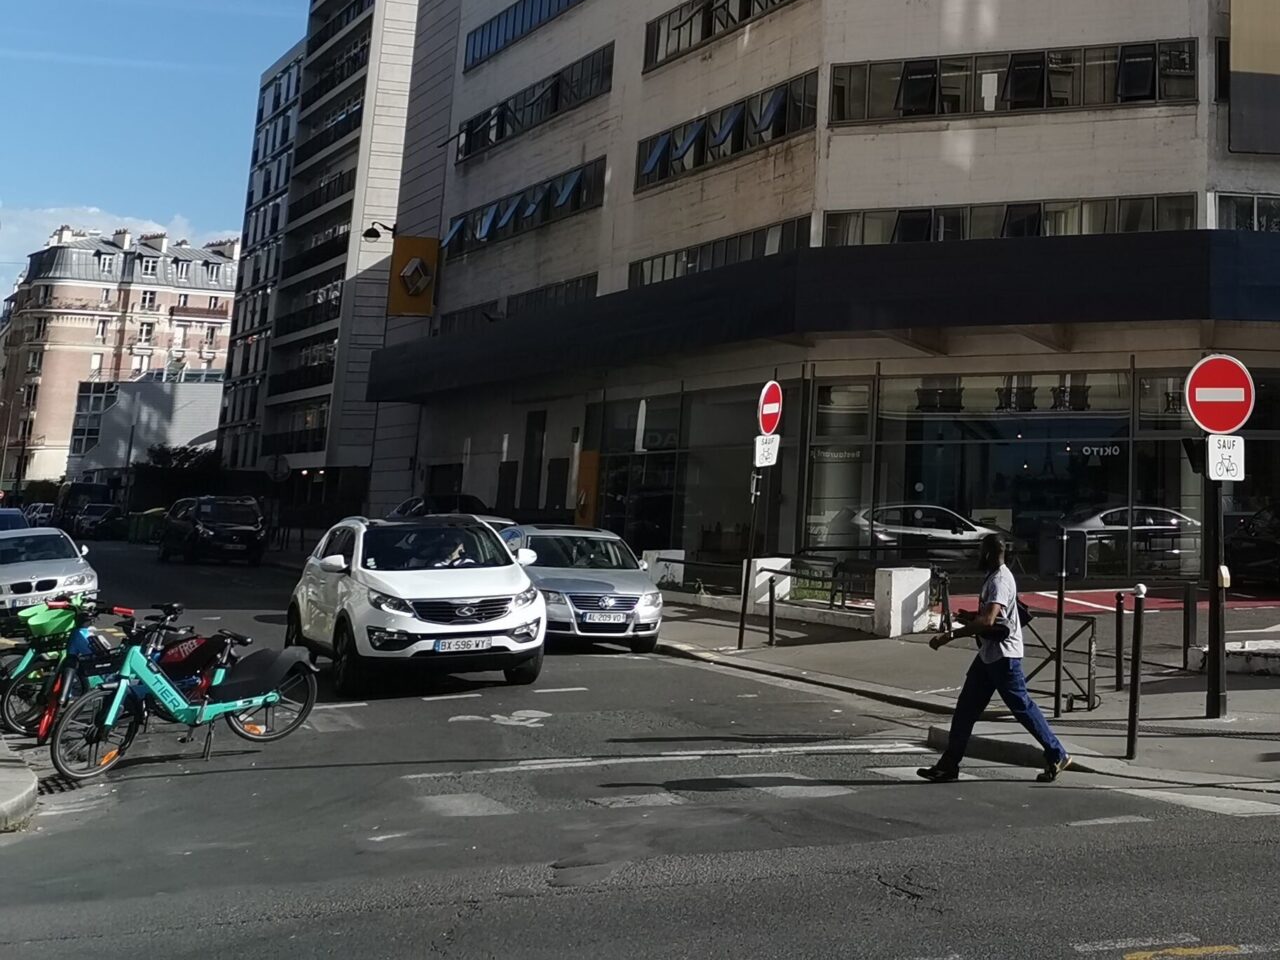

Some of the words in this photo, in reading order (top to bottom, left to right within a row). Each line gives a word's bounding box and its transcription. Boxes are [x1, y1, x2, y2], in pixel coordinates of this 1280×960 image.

[1217, 439, 1236, 450] SAUF
[179, 639, 199, 658] FREE
[152, 676, 181, 710] TIER
